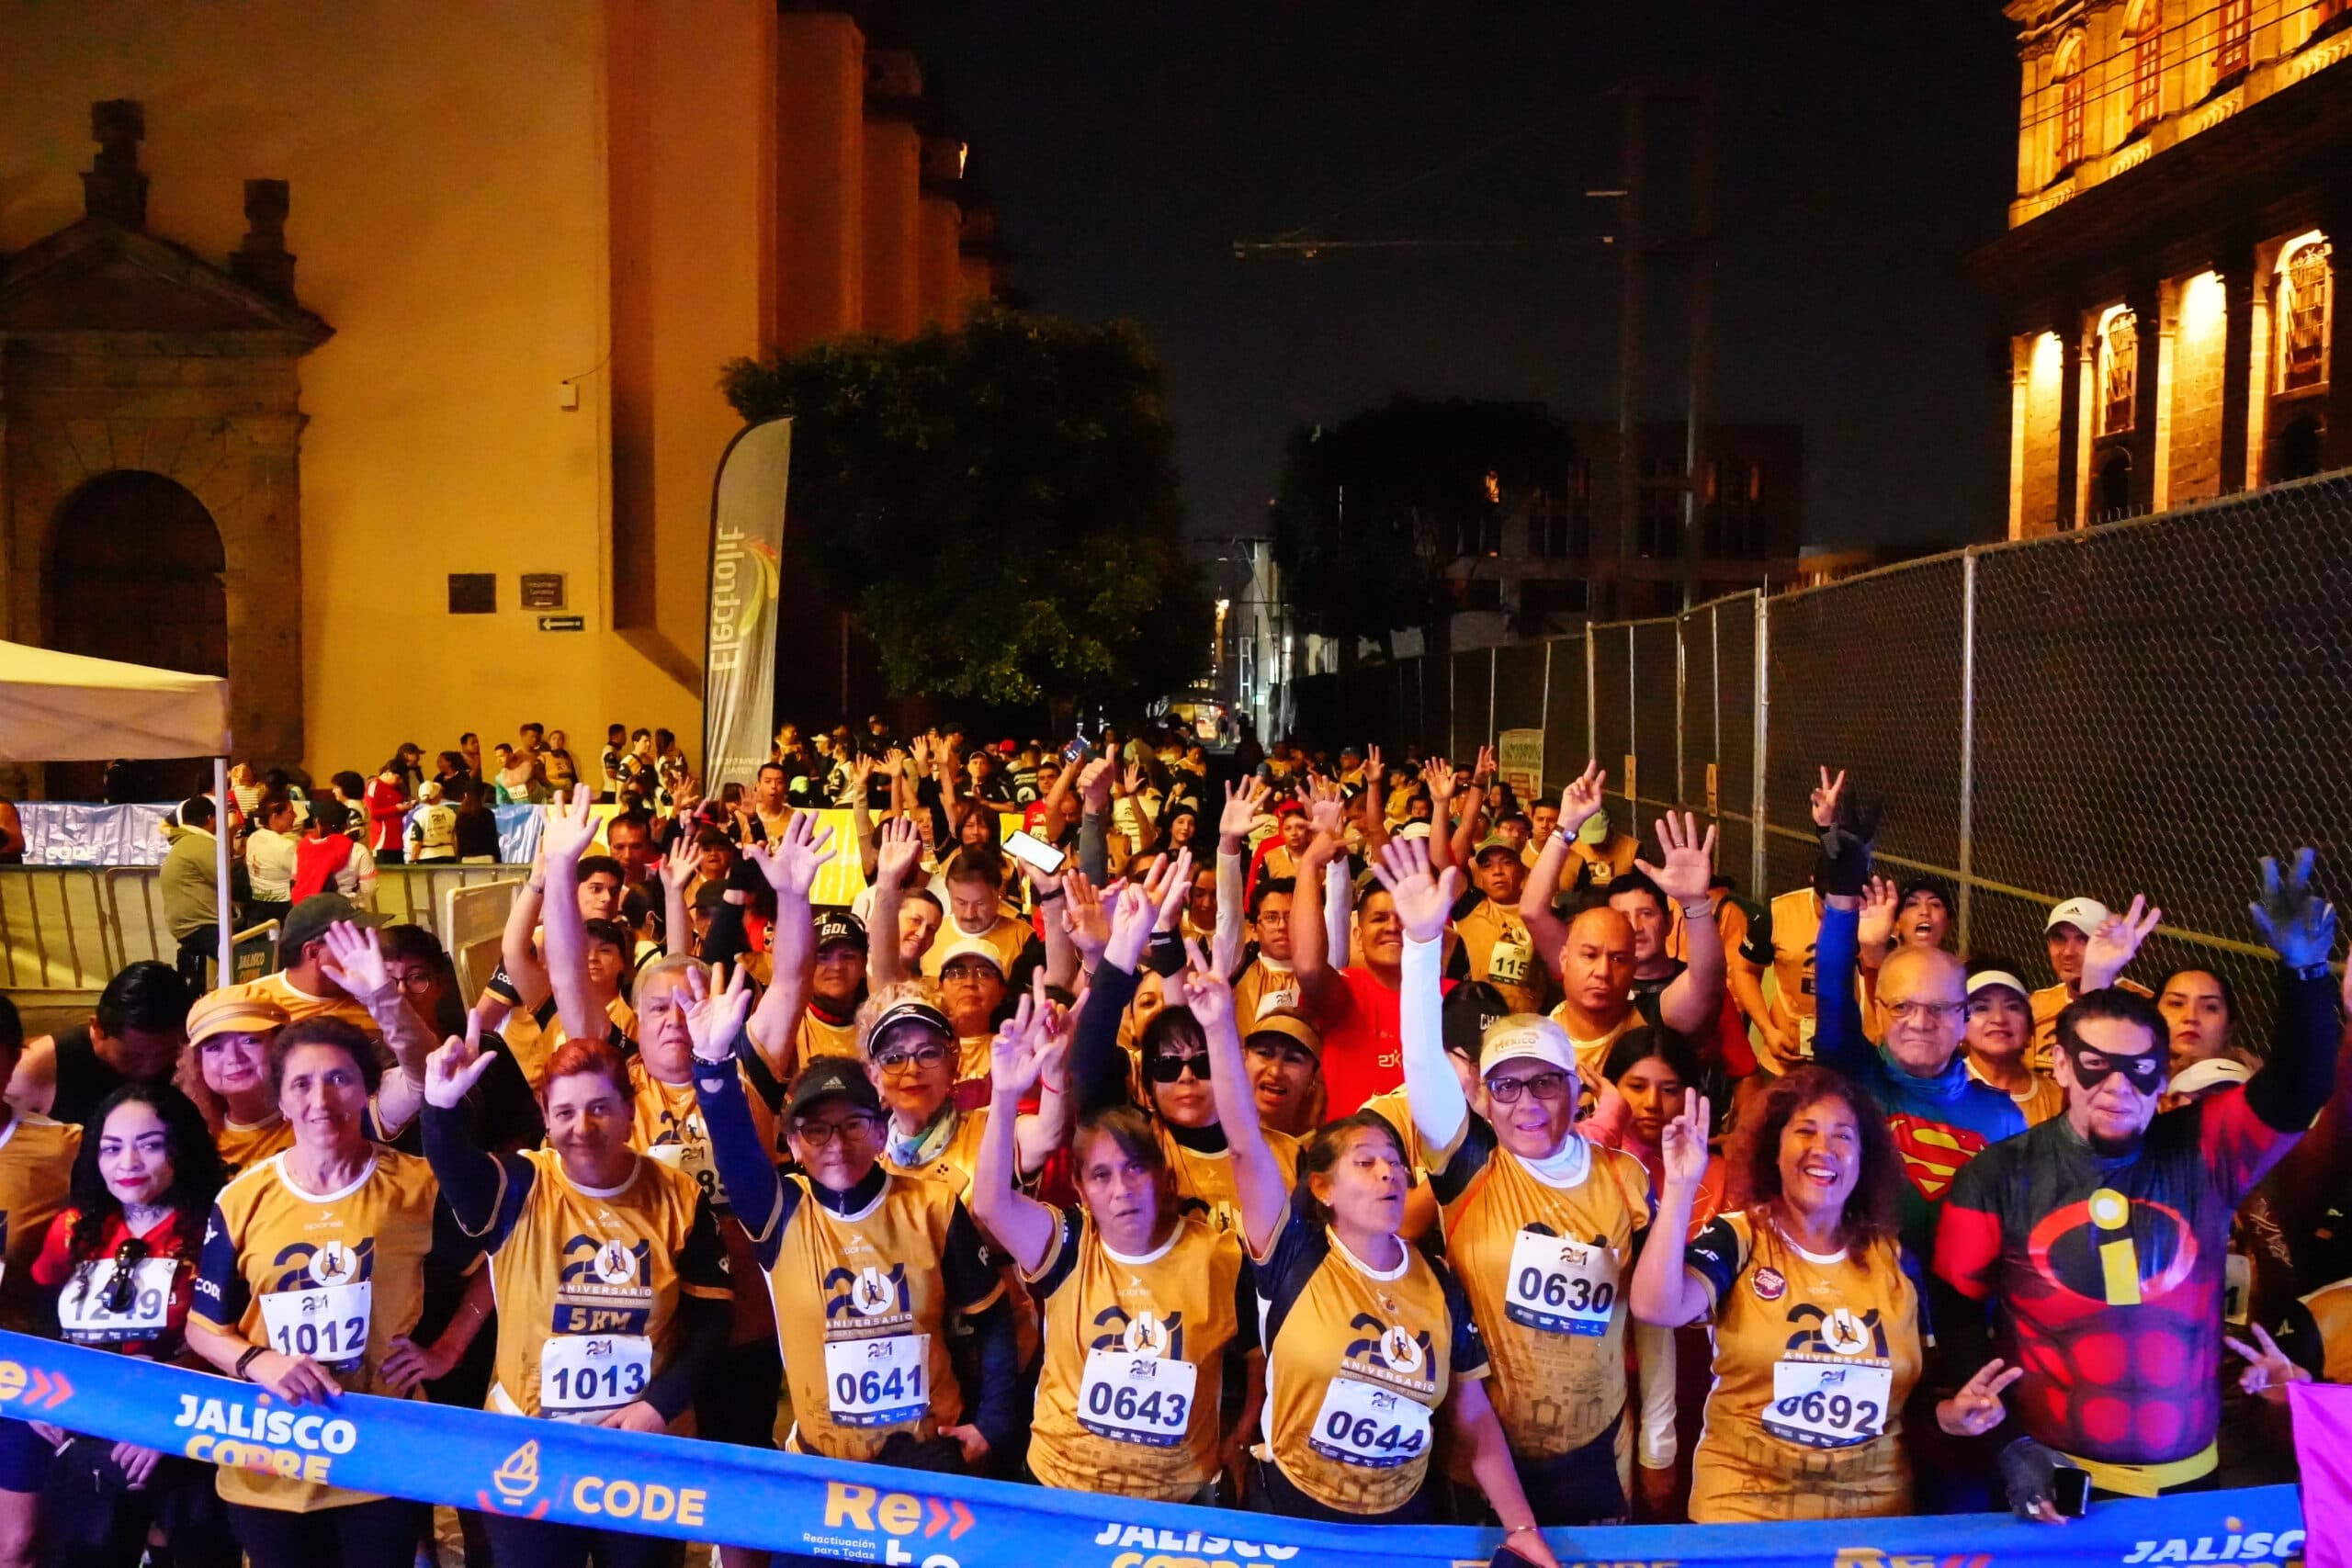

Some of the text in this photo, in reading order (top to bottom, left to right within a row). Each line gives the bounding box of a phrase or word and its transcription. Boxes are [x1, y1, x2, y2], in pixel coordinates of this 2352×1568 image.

[46, 846, 96, 860] CODE
[821, 922, 848, 936] GDL
[559, 1284, 653, 1297] ANIVERSARIO
[1519, 1267, 1614, 1314] 0630
[278, 1316, 366, 1357] 1012
[825, 1314, 912, 1328] ANIVERSARIO
[1341, 1359, 1435, 1392] ANIVERSARIO
[1783, 1352, 1890, 1368] ANIVERSARIO
[552, 1363, 645, 1401] 1013
[836, 1364, 922, 1404] 0641
[175, 1393, 356, 1454] JALISCO
[1089, 1382, 1186, 1427] 0643
[1777, 1391, 1879, 1435] 0692
[1327, 1411, 1424, 1452] 0644
[573, 1476, 707, 1527] CODE
[813, 1546, 875, 1559] para Todas
[2122, 1517, 2307, 1563] JALISC
